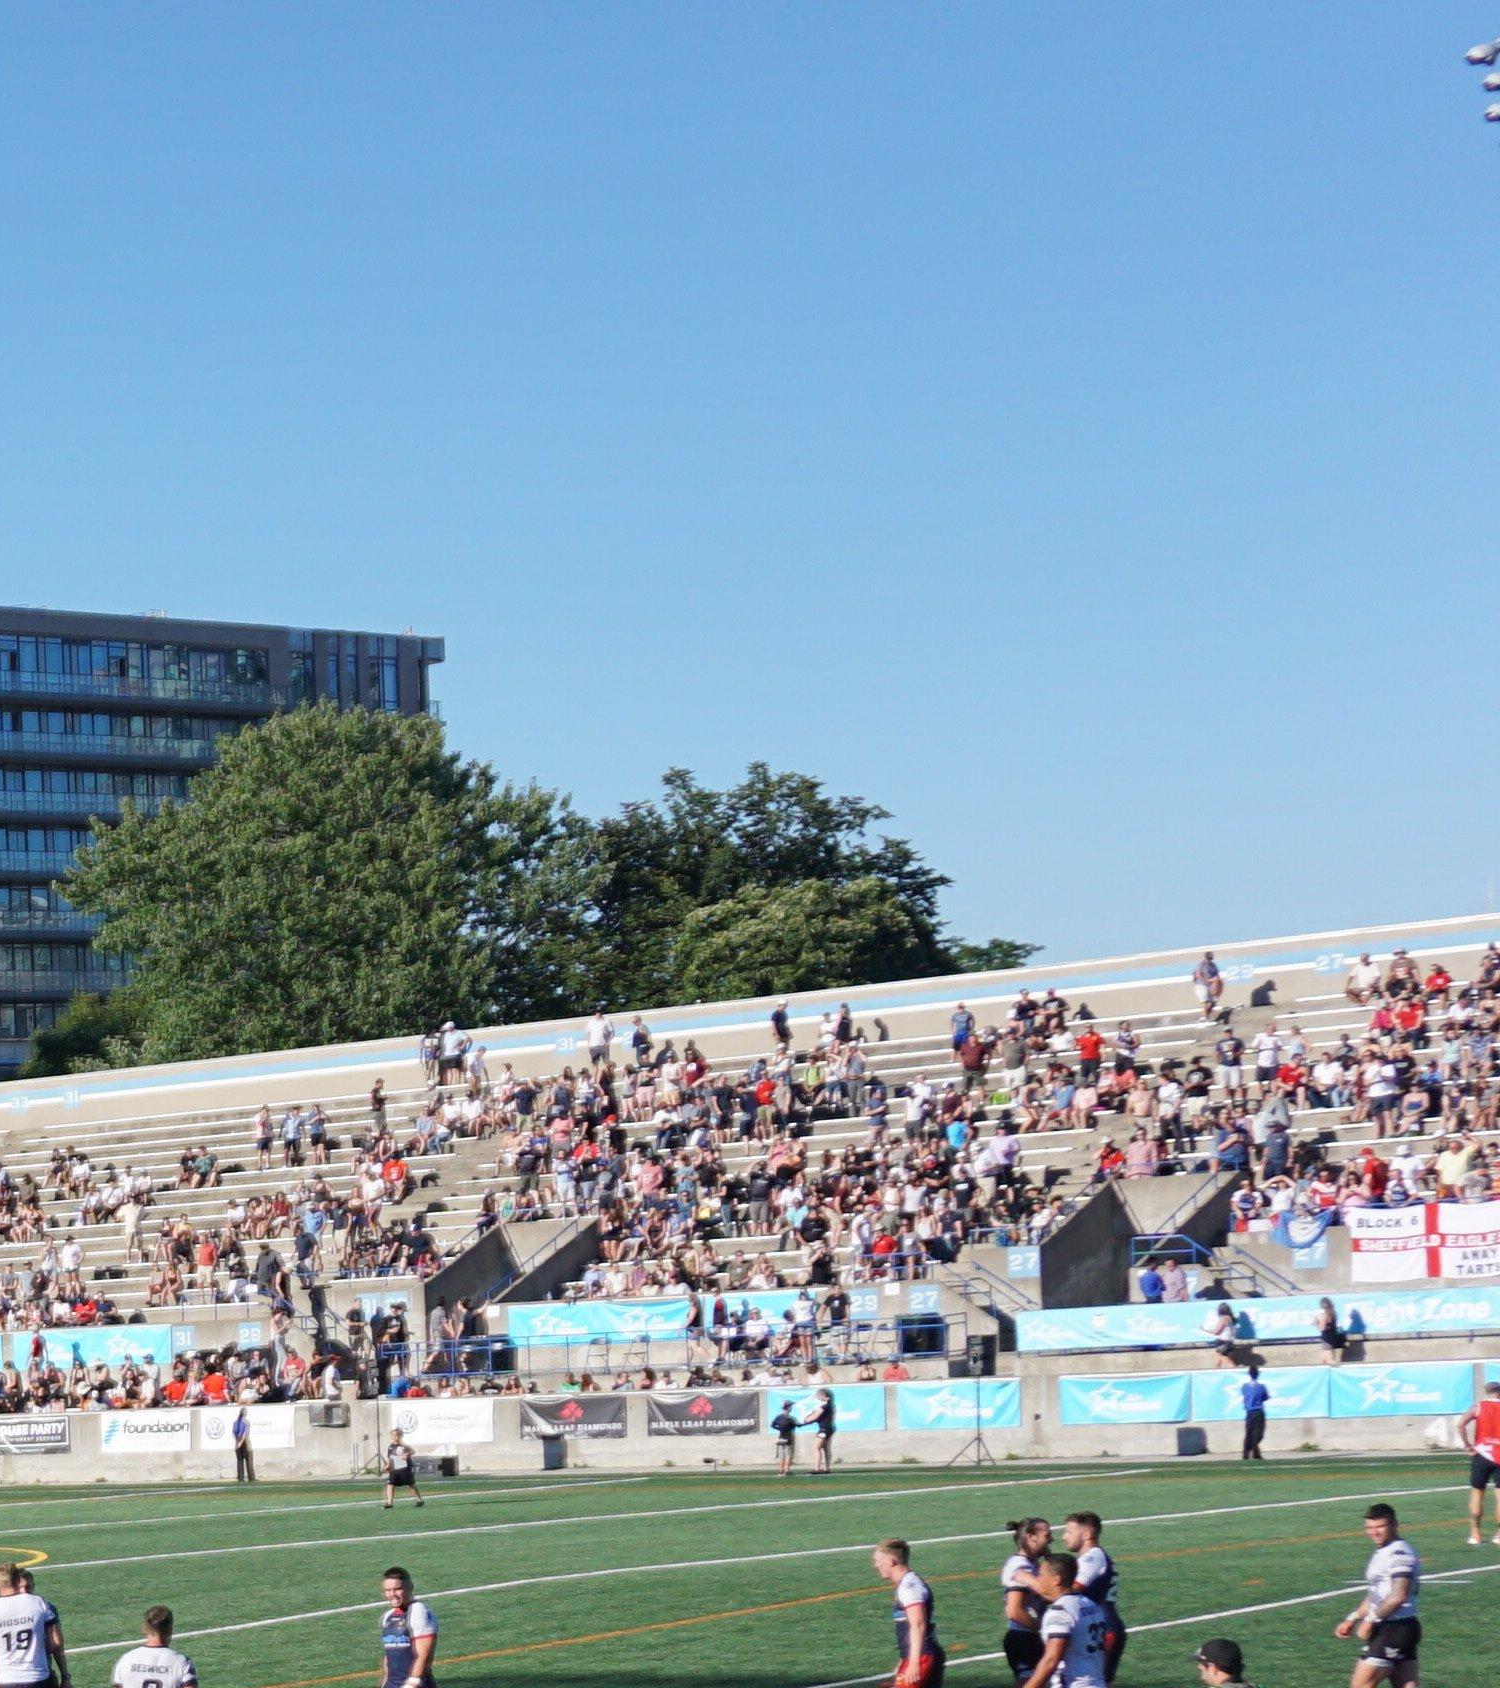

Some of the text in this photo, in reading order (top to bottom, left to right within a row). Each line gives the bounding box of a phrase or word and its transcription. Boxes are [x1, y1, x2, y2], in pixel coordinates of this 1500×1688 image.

[1357, 1215, 1419, 1228] BLOCK 6
[1360, 1231, 1500, 1251] SHEFFIELD EAGLE
[1009, 1253, 1040, 1269] 27
[1462, 1248, 1497, 1260] AWAY
[910, 1292, 938, 1309] 27
[176, 1330, 192, 1346] 31
[240, 1328, 261, 1343] 29
[30, 1421, 65, 1436] PARTY
[123, 1417, 190, 1435] foundation
[578, 1421, 623, 1431] DIAMONDS
[706, 1418, 756, 1428] DIAMONDS
[2, 1628, 33, 1653] 19
[130, 1662, 172, 1674] BESWICK
